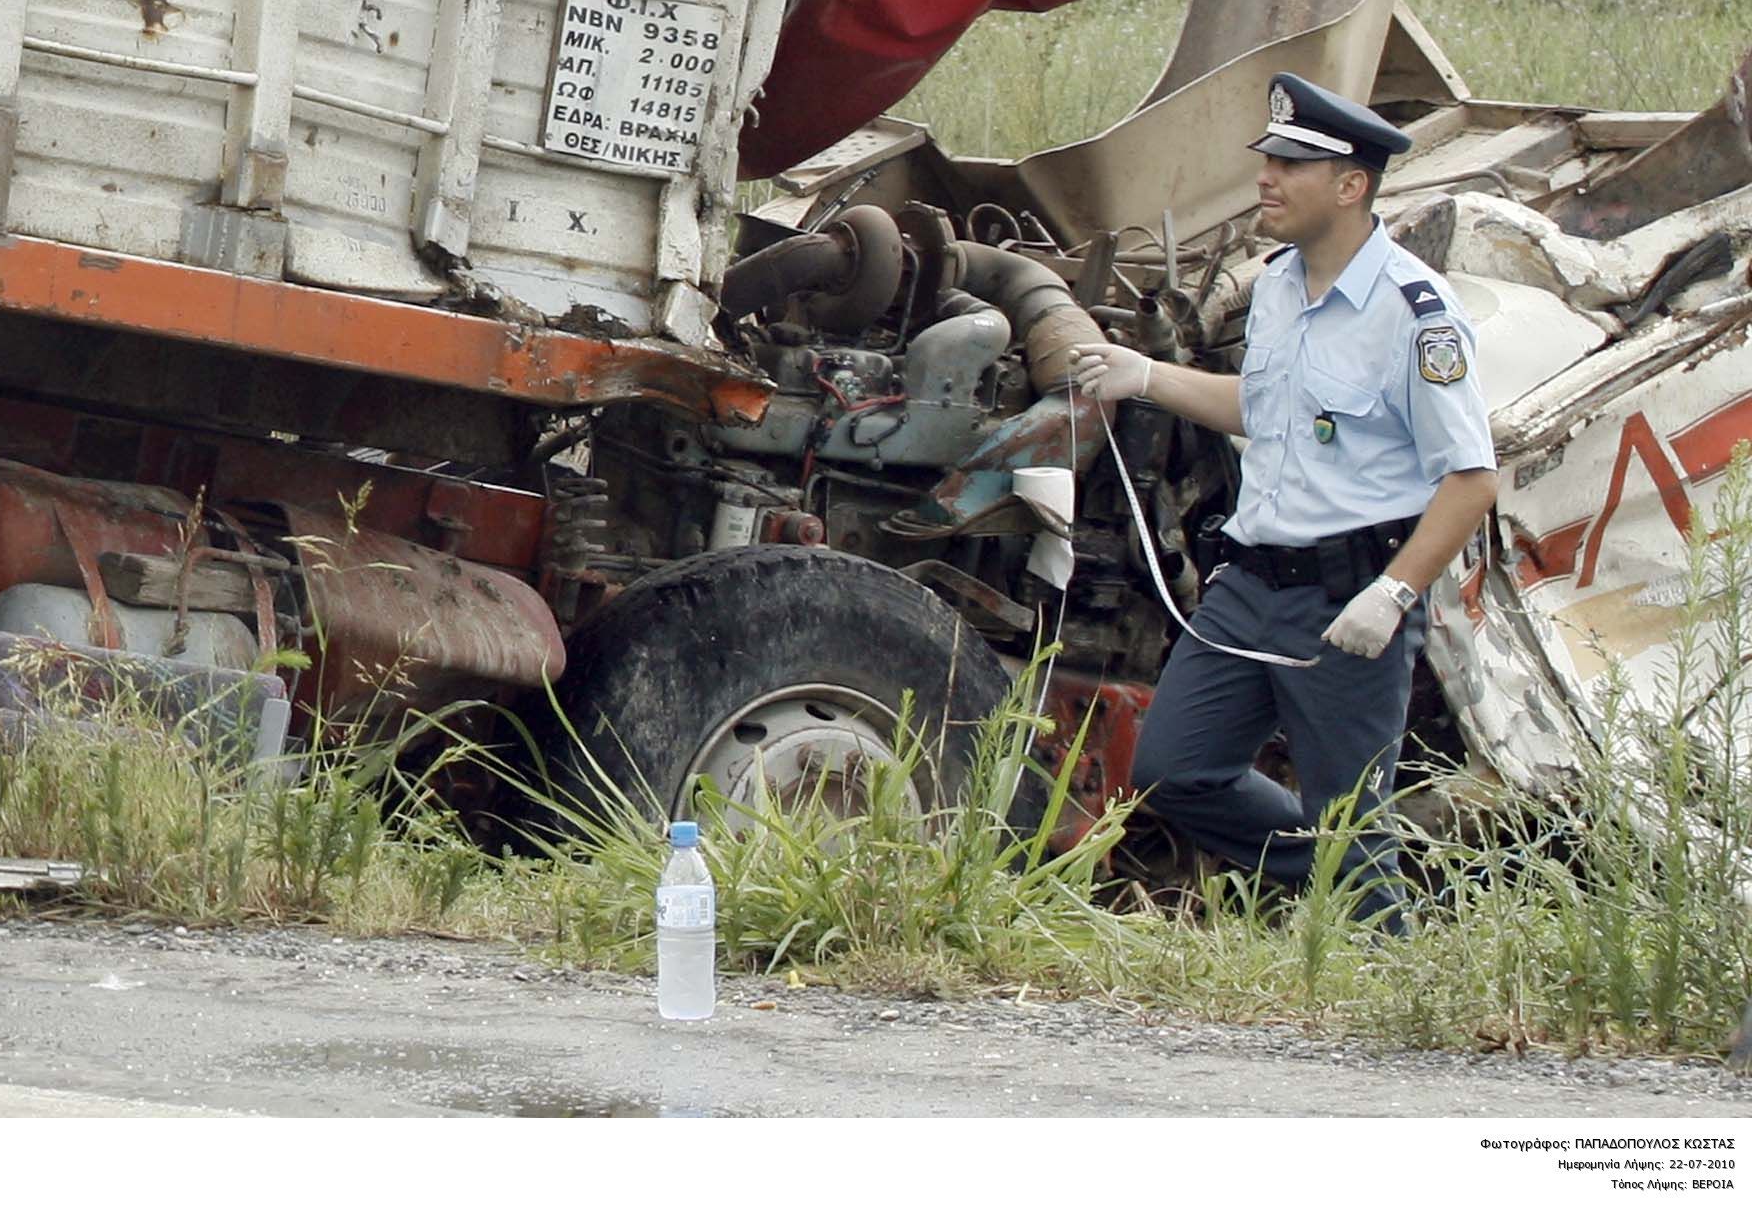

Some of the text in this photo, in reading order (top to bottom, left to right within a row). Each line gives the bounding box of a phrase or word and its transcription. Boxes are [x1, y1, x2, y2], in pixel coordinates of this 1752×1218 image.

[568, 5, 719, 50] ΝΒΝ 9358
[564, 30, 714, 74] ΜΙΚ. 2.000
[559, 56, 704, 98] ΑΠ. 11185
[556, 81, 696, 122] ΩΦ 14815
[553, 105, 698, 146] ΕΔΡΑ: ΒΡΑΧΙΑ
